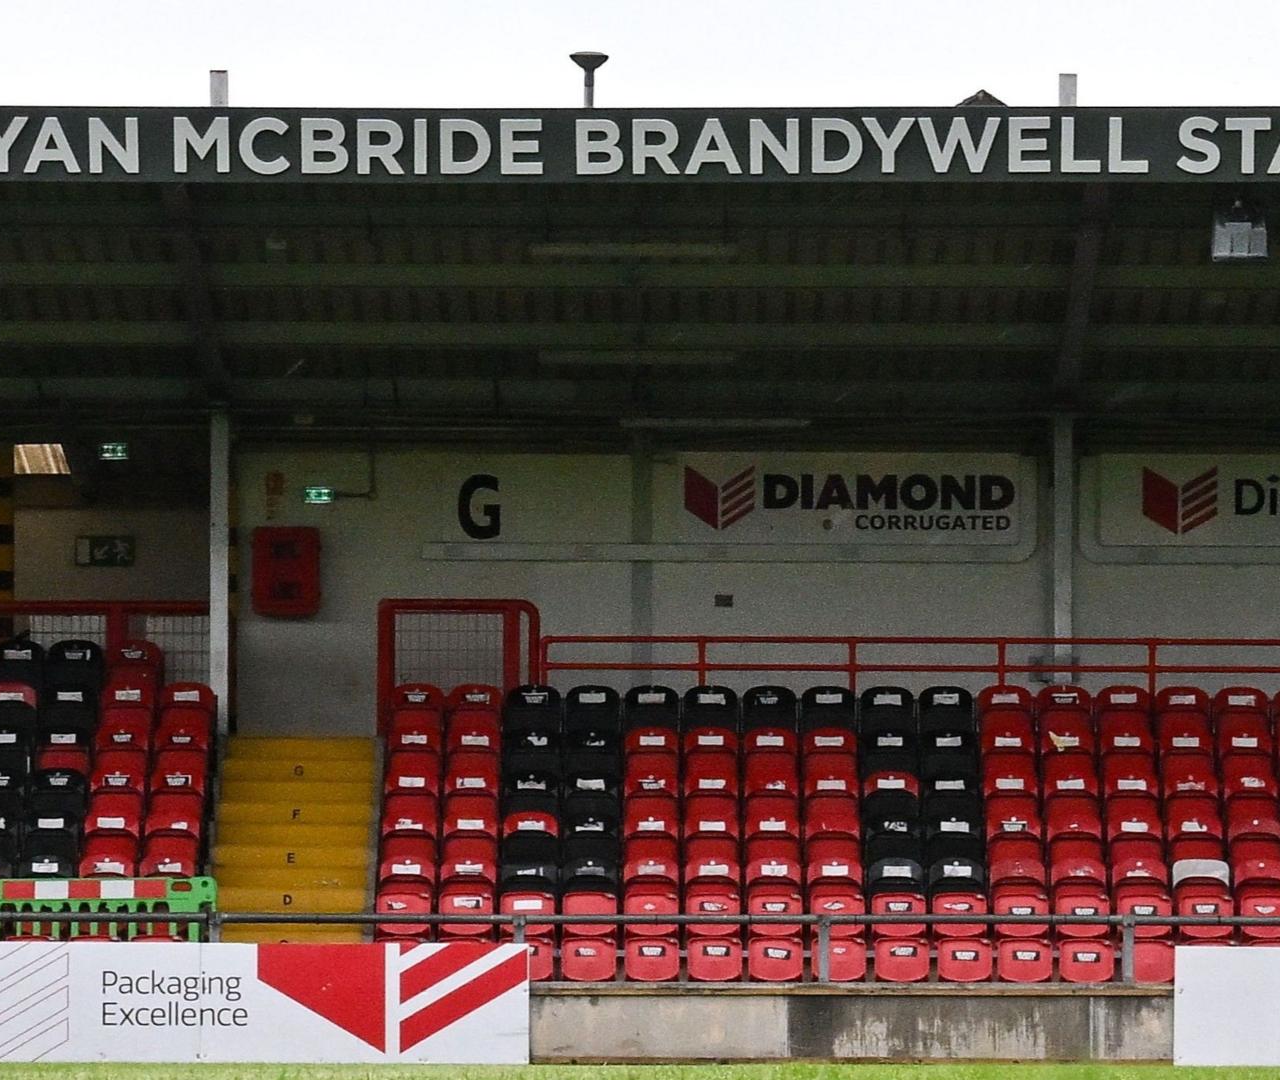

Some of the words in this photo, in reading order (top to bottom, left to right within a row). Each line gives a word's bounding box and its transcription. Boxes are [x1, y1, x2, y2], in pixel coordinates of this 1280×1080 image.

[173, 117, 545, 176] MCBRIDE
[576, 117, 1150, 176] BRANDYWELL
[762, 473, 1015, 511] DIAMOND
[458, 473, 501, 540] G
[854, 514, 1011, 531] CORRUGATED
[293, 765, 304, 777] G
[291, 808, 301, 820] F
[286, 852, 296, 864] E
[282, 894, 293, 906] D
[101, 969, 242, 1002] Packaging
[101, 1000, 249, 1027] Excellence
